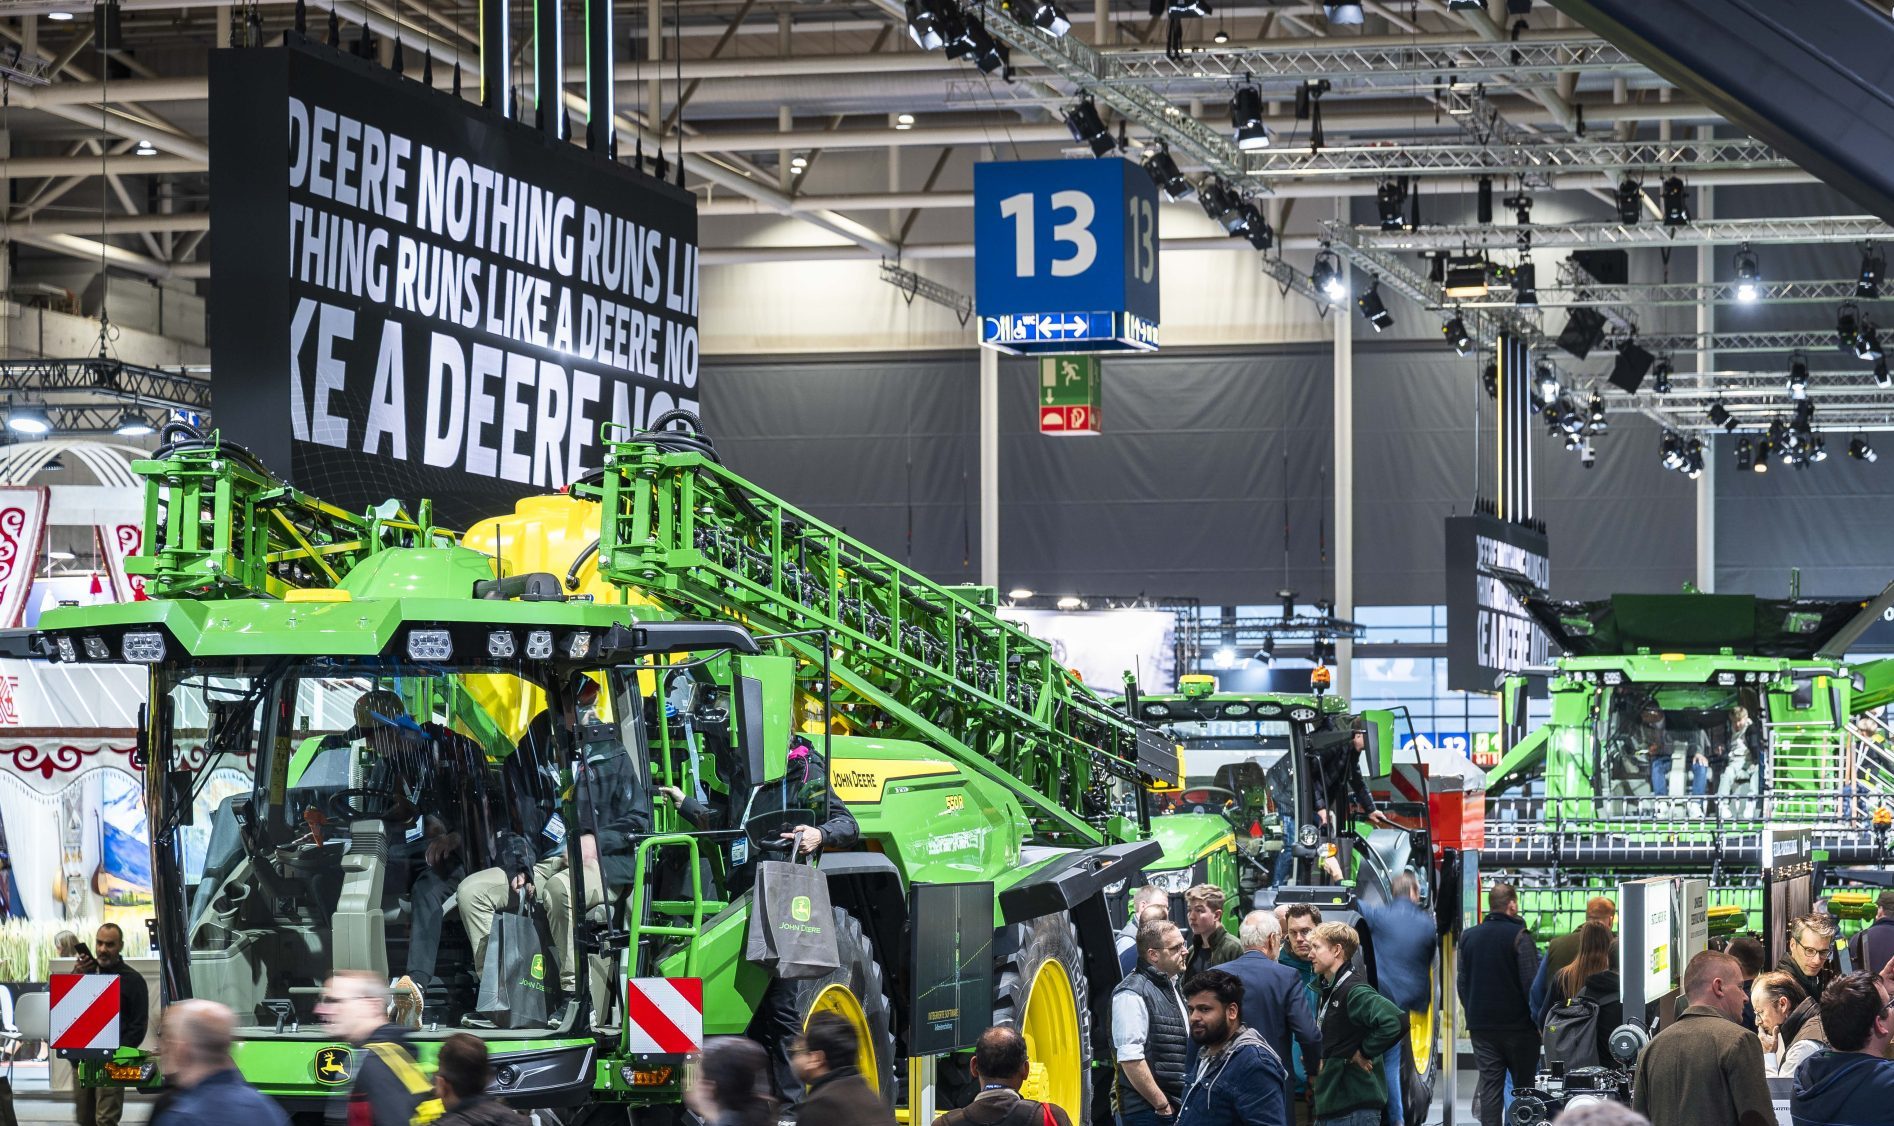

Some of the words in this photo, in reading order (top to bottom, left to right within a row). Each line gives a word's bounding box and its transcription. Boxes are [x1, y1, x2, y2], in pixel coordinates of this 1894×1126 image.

[417, 145, 575, 277] NOTHING
[581, 205, 661, 304] RUNS
[1000, 190, 1097, 278] 13
[1129, 195, 1154, 284] 13
[396, 235, 480, 329] RUNS
[487, 264, 550, 348] LIKE
[553, 286, 573, 353] A
[580, 293, 660, 378] DEERE
[664, 319, 698, 389] NO
[363, 319, 407, 461] A
[424, 331, 600, 490] DEERE
[1489, 612, 1498, 668] A
[1498, 614, 1531, 672] DEERE
[832, 770, 852, 788] JOHN
[852, 770, 877, 788] DEERE
[779, 921, 800, 931] JOHN
[519, 977, 536, 989] JOHN
